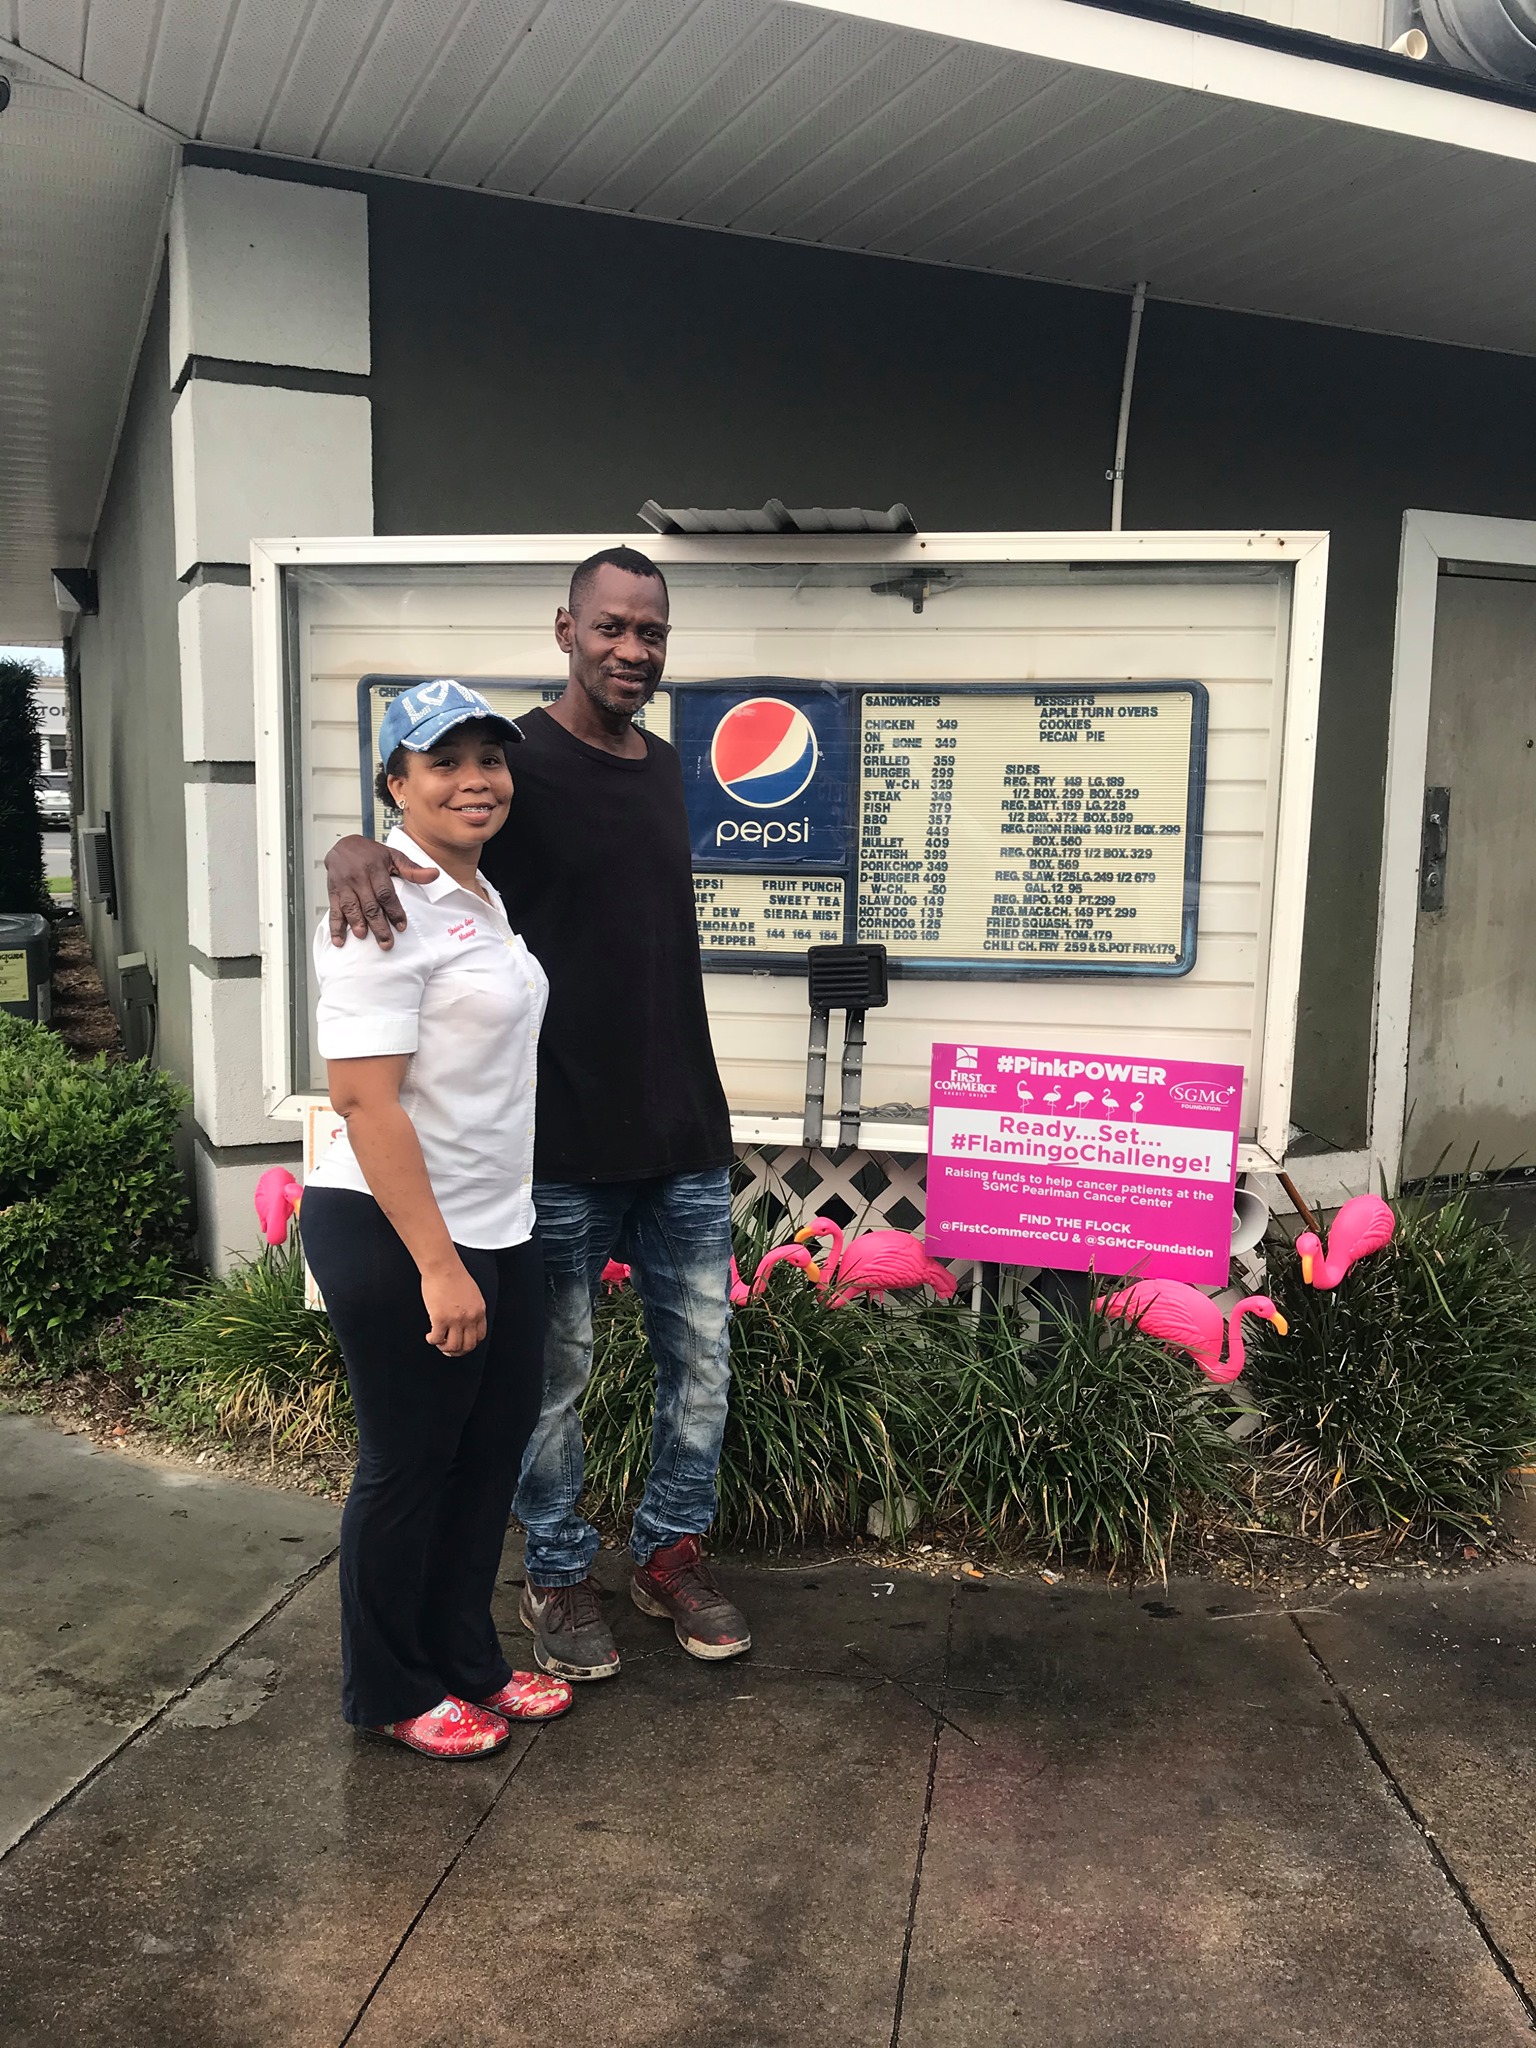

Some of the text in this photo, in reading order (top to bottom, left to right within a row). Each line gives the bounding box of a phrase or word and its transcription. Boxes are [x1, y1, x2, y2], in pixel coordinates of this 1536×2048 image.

[865, 696, 940, 707] SANDWICHES
[1035, 695, 1095, 706] DESSERTS
[1040, 706, 1158, 718] APPLE TURN OVERS
[864, 719, 958, 730] CHICKEN 349
[1039, 719, 1092, 730] COOKIES
[864, 732, 880, 742] ON
[1039, 731, 1105, 742] PECAN PIE
[892, 738, 957, 748] BONE 349
[864, 744, 885, 754] OFF
[863, 755, 956, 766] GRILLED 359
[864, 767, 954, 778] BURGER 299
[1005, 765, 1040, 775] SIDES
[931, 779, 953, 790] 329
[1003, 776, 1031, 787] REG.
[1034, 777, 1056, 787] FRY
[864, 791, 953, 801] STEAK 349
[1012, 789, 1030, 799] 1/2
[863, 803, 952, 814] FISH 379
[863, 814, 951, 825] BBQ 357
[1008, 812, 1025, 822] 1/2
[716, 816, 810, 848] pepsi
[863, 826, 949, 837] RIB 449
[1064, 824, 1091, 835] RING
[1114, 825, 1131, 835] 1/2
[861, 837, 949, 848] MULLET 409
[860, 849, 947, 860] CATFISH 399
[1084, 848, 1101, 858] 1/2
[927, 861, 949, 872] 349
[1057, 860, 1080, 870] 569
[860, 872, 946, 883] D-BURGER 409
[995, 870, 1020, 881] REG.
[1116, 872, 1133, 883] 1/2
[1134, 872, 1156, 883] 679
[692, 879, 723, 890] EPSI
[762, 880, 842, 893] FRUIT PUNCH
[769, 896, 841, 907] SWEET TEA
[859, 895, 945, 906] SLAW DOG 149
[994, 894, 1020, 904] REG.
[1054, 895, 1073, 905] 149
[713, 907, 740, 918] DEW
[763, 909, 841, 921] SIERRA MIST
[858, 907, 943, 918] HOT DOG 135
[1074, 907, 1094, 917] 149
[1114, 907, 1137, 918] 299
[986, 917, 1020, 928] FRIED
[1074, 919, 1094, 929] 179
[766, 929, 785, 940] 144
[858, 929, 889, 940] CHILI
[893, 930, 917, 940] DOG
[986, 928, 1019, 939] FRIED
[711, 935, 756, 946] PEPPER
[983, 940, 1014, 951] CHILI
[1040, 942, 1059, 952] FRY
[1064, 942, 1087, 952] 259
[1088, 943, 1097, 953] &
[950, 1069, 982, 1083] FIRST
[997, 1055, 1167, 1086] #PinkPOWER
[934, 1080, 998, 1094] COMMERCE
[1174, 1086, 1230, 1105] SGMC
[1181, 1103, 1221, 1112] FOUNDATION
[950, 1133, 1212, 1174] #FlamingoChallenge!
[944, 1166, 1214, 1202] Raising funds to help cancer patients at the
[982, 1180, 1173, 1209] SGMC Pearlman Cancer Center
[1019, 1213, 1131, 1235] FIND THE FLOCK
[939, 1220, 1214, 1259] @FirstCommerceCU & @SGMCFoundation
